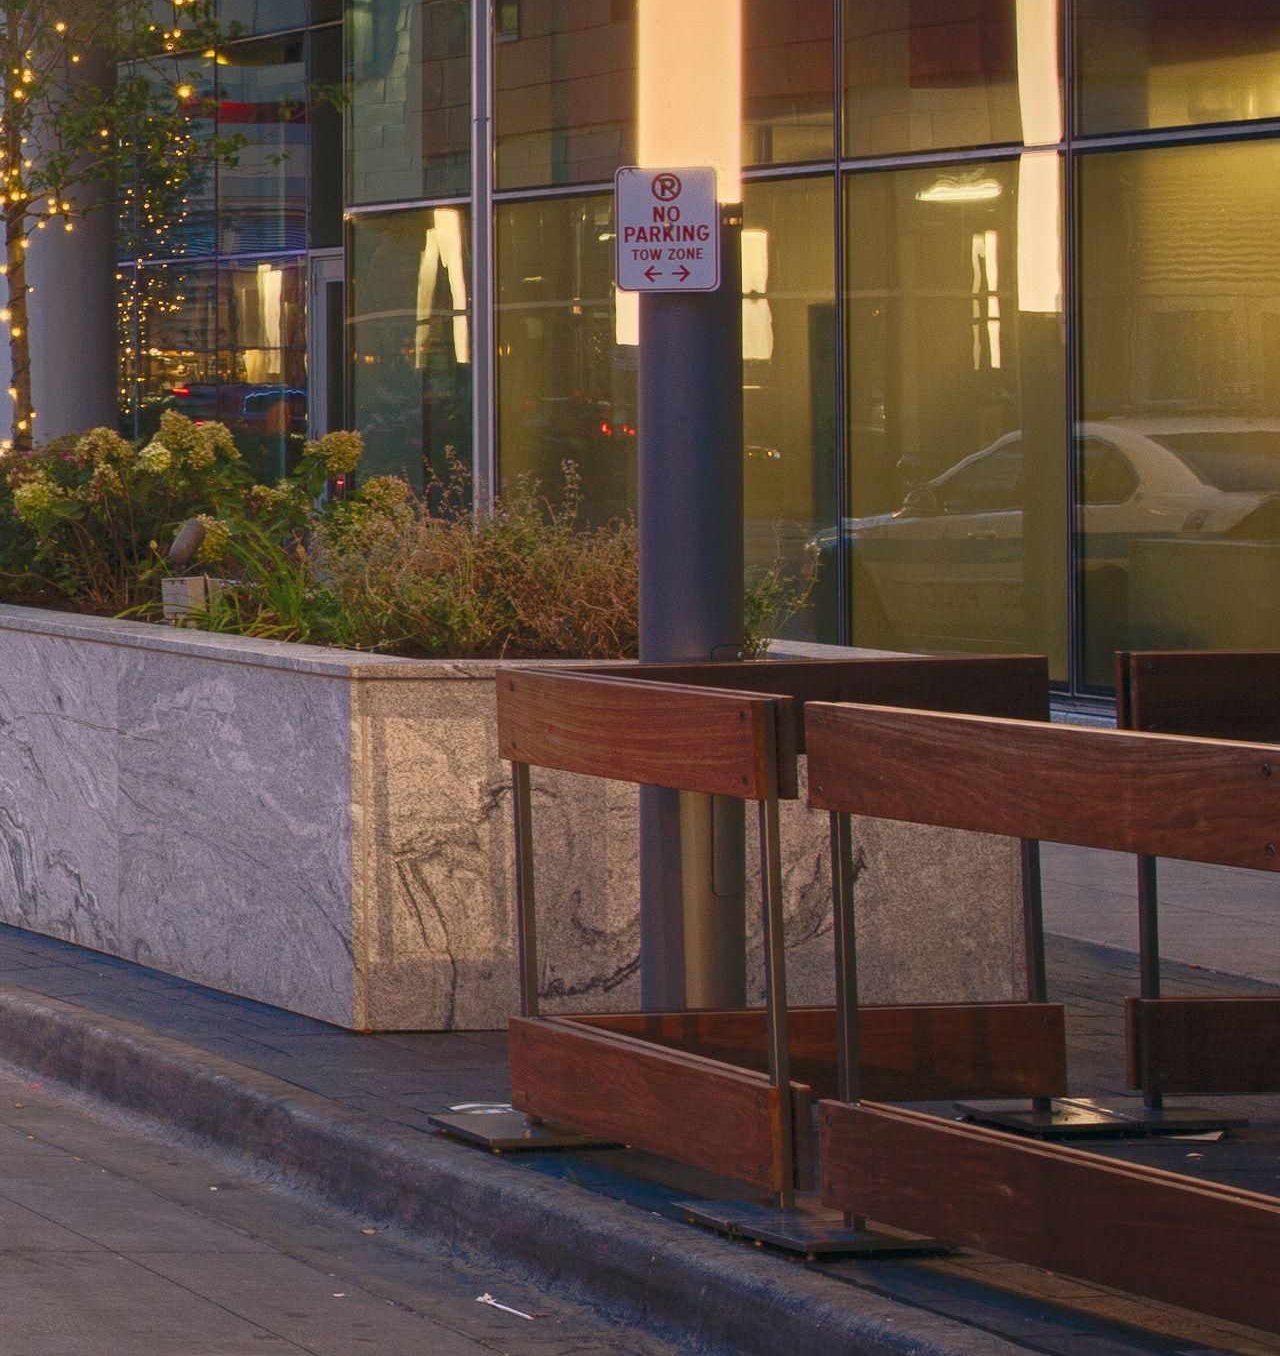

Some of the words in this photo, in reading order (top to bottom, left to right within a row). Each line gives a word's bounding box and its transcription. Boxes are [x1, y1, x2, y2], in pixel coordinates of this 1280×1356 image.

[652, 206, 681, 223] NO
[624, 224, 710, 243] PARKING
[632, 249, 662, 261] TOW
[668, 248, 704, 260] ZONE
